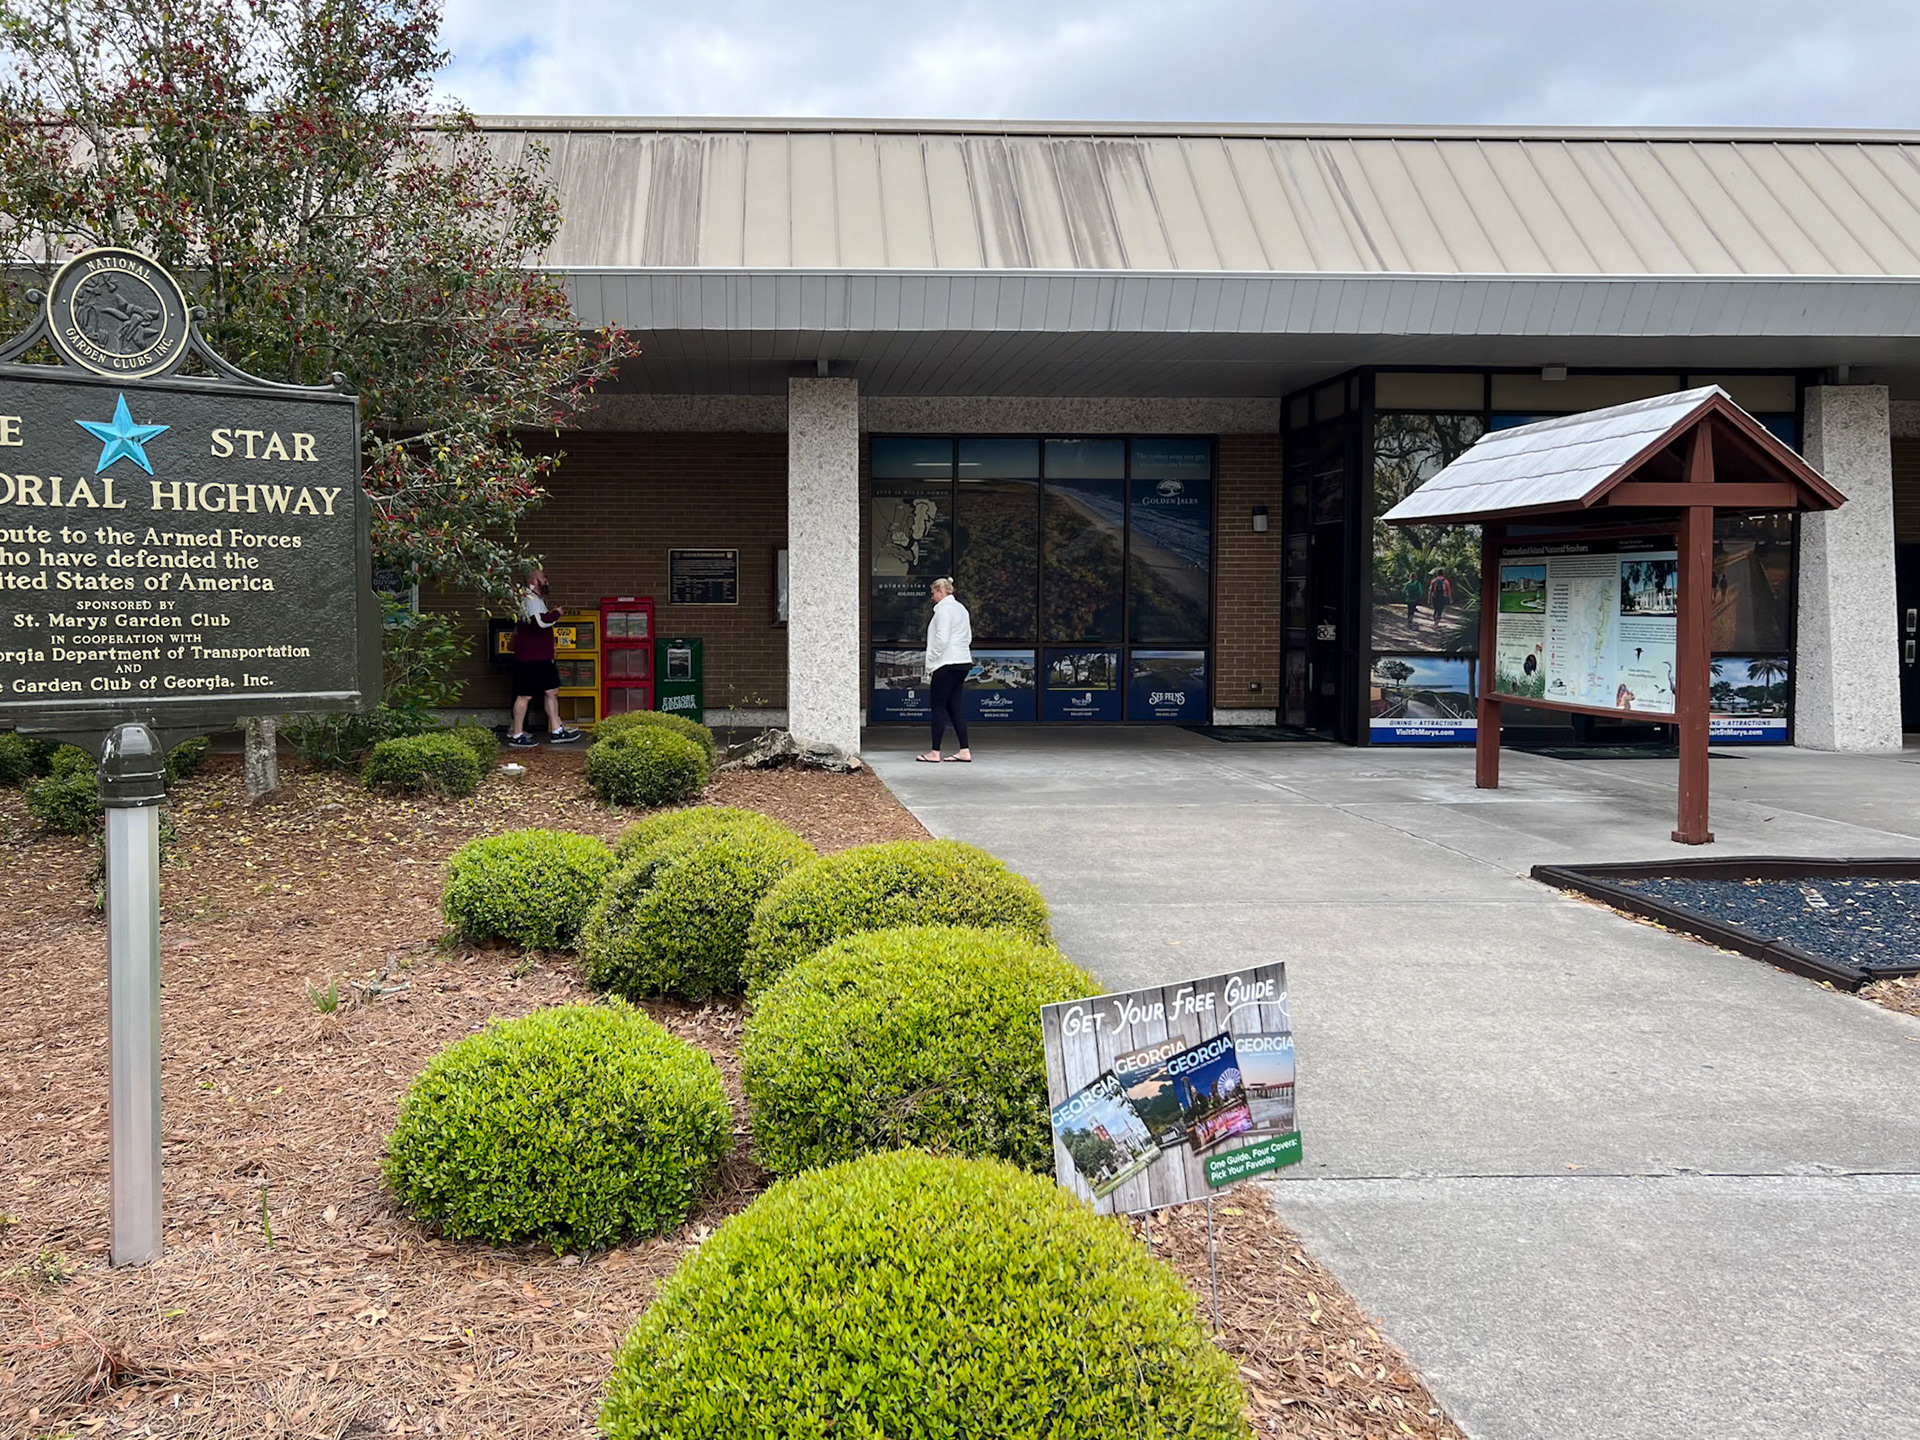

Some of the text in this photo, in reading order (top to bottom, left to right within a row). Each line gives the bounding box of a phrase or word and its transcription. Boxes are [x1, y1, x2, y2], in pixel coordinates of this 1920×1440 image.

[85, 257, 151, 280] NATIONAL
[65, 327, 174, 369] GARDEN CLUBS INC.
[210, 428, 319, 462] STAR
[0, 471, 342, 516] ORIAL HIGHWAY
[1142, 496, 1199, 506] GOLDEN ISLES
[60, 525, 87, 545] to
[95, 527, 135, 546] the
[143, 528, 221, 547] Armed
[229, 529, 301, 549] Forces
[39, 548, 97, 567] have
[106, 549, 216, 569] defended
[223, 551, 259, 569] the
[56, 570, 135, 591] States
[143, 572, 172, 591] of
[180, 574, 274, 592] America
[76, 600, 176, 611] SPONSORED BY
[13, 613, 231, 630] St. Marys Garden Club
[51, 634, 202, 645] IN COOPERATION WITH
[52, 646, 160, 664] Department
[167, 646, 185, 660] of
[190, 645, 311, 661] Transportation
[115, 663, 143, 674] AND
[12, 679, 82, 694] Garden
[90, 677, 132, 692] Club
[139, 676, 158, 690] of
[243, 674, 274, 687] Inc.
[661, 701, 698, 711] GEORGIA
[662, 694, 696, 704] EXPLORE
[1395, 728, 1455, 737] VisitStMarys.com
[1062, 975, 1275, 1037] GET YOUR FREE GUIDE
[1235, 1036, 1294, 1053] GEORGIA
[1115, 1040, 1187, 1075] GEORGIA
[1167, 1035, 1235, 1076] GEORGIA
[1052, 1074, 1120, 1127] GEORGIA
[1210, 1160, 1226, 1171] One
[1252, 1146, 1271, 1158] Four
[1210, 1155, 1277, 1182] Pick Your Favorite
